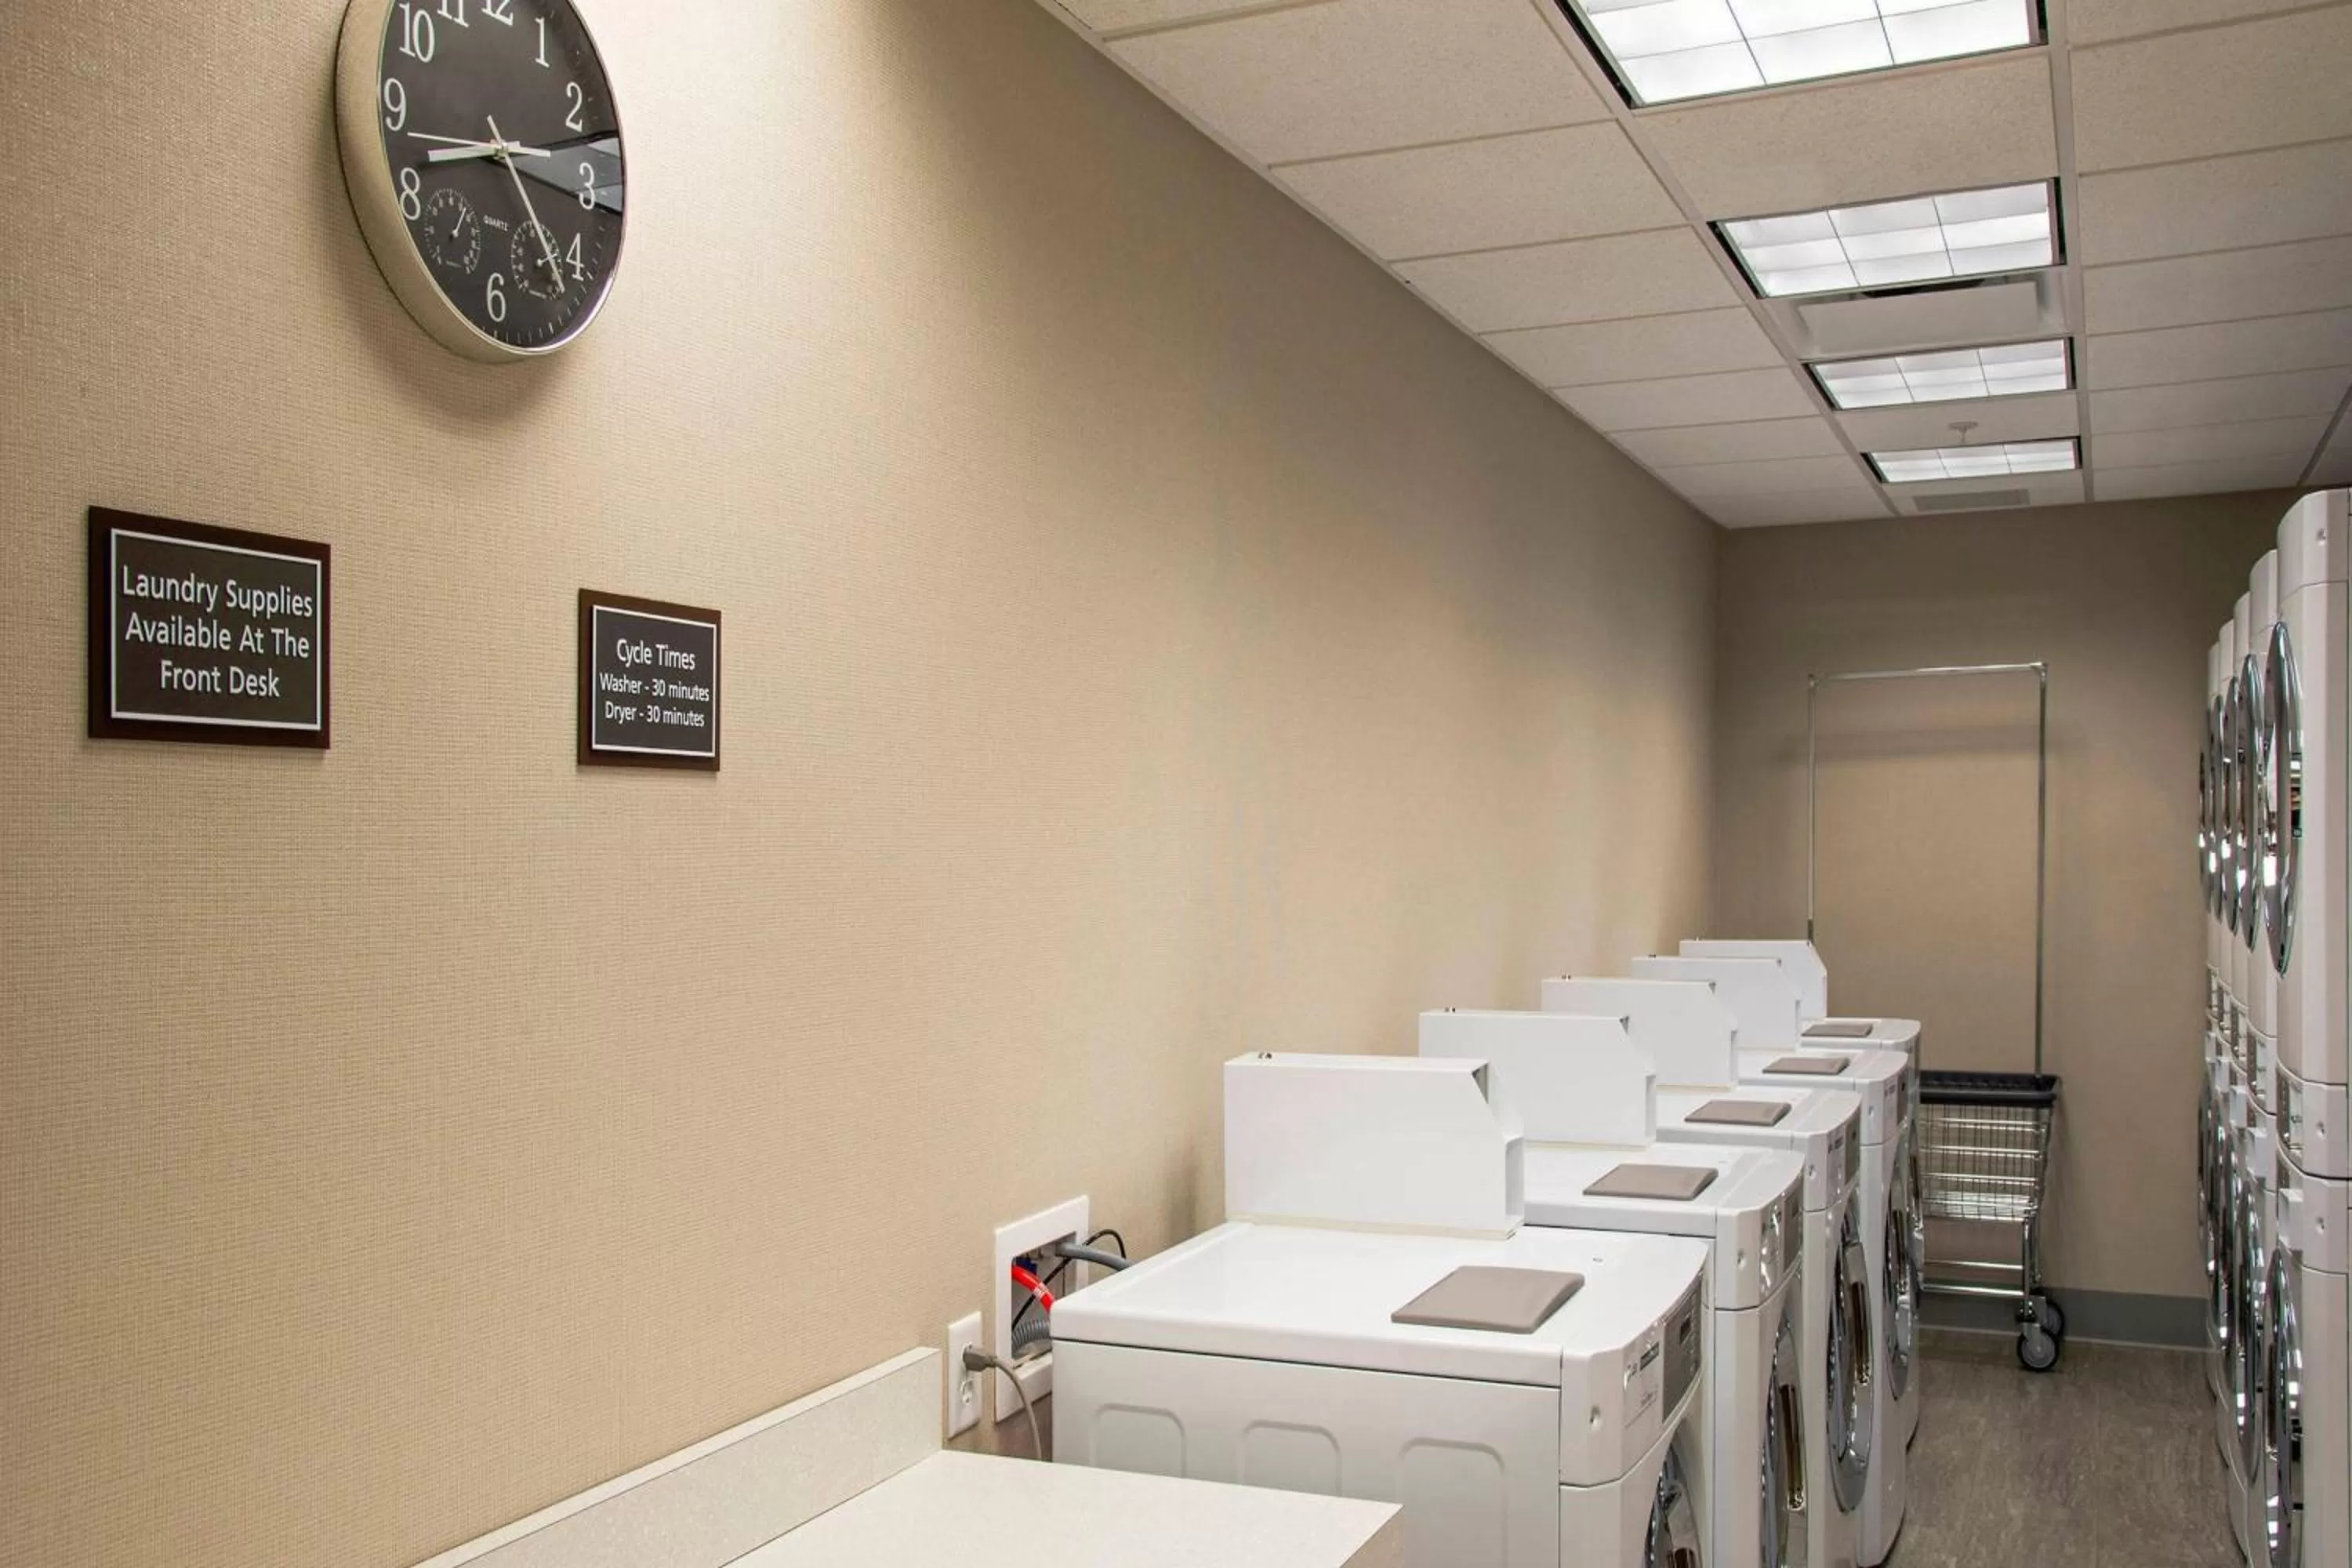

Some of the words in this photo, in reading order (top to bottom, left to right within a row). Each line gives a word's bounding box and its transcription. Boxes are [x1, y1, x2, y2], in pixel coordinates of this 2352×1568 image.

[399, 2, 435, 64] 10
[535, 17, 550, 68] 1
[383, 78, 407, 132] 9
[565, 82, 583, 132] 2
[400, 167, 421, 221] 8
[578, 162, 596, 211] 3
[565, 233, 584, 281] 4
[486, 272, 506, 322] 6
[123, 564, 219, 612] Laundry
[226, 579, 313, 619] Supplies
[125, 612, 231, 650] Available
[239, 625, 264, 654] At
[271, 627, 310, 658] The
[617, 638, 652, 667] Cycle
[655, 644, 695, 670] Times
[161, 659, 221, 692] Front
[230, 666, 280, 697] Desk
[600, 673, 642, 694] Washer
[652, 679, 666, 697] 30
[669, 681, 710, 702] minutes
[605, 700, 637, 724] Dryer
[647, 705, 661, 723] 30
[663, 707, 705, 728] minutes
